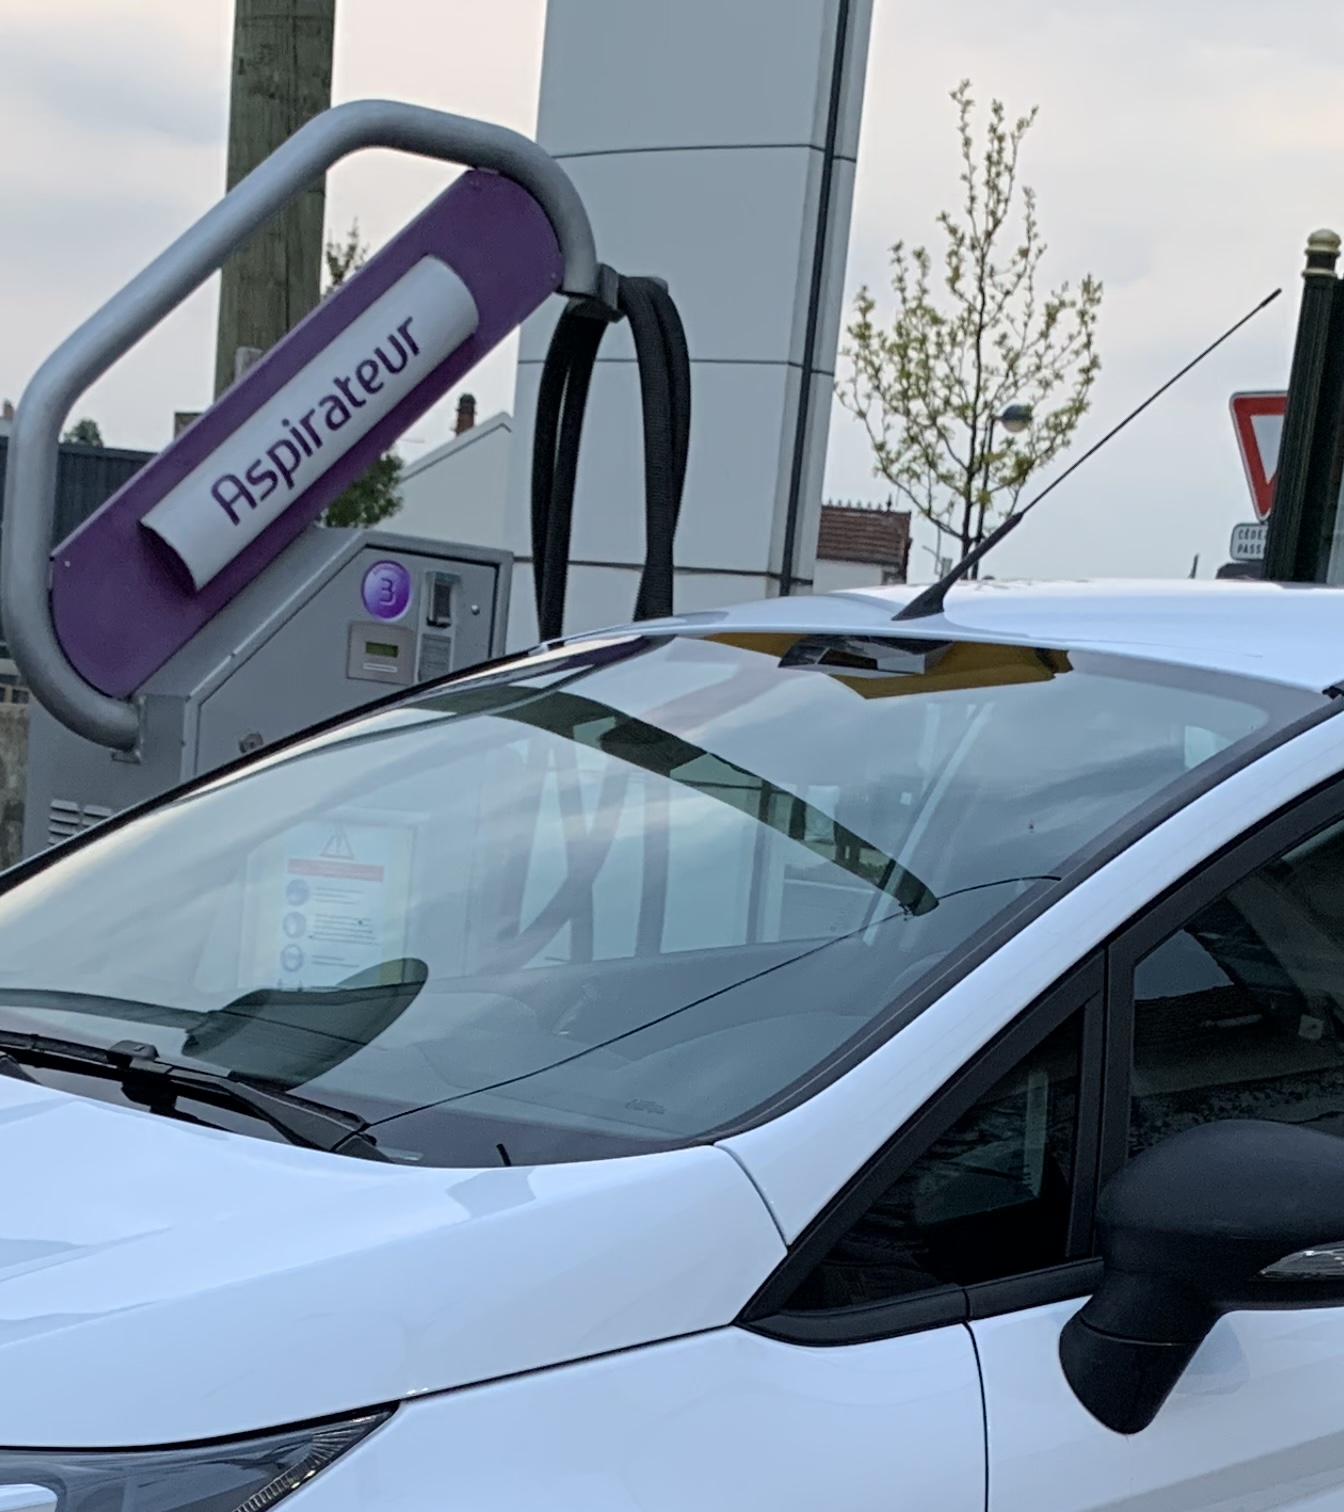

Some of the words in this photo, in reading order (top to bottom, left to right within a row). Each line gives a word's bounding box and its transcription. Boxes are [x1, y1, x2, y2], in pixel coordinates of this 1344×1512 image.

[210, 316, 420, 526] Aspirateur
[1238, 527, 1267, 540] CÉDE
[1237, 543, 1262, 555] PASS
[380, 577, 396, 606] 3
